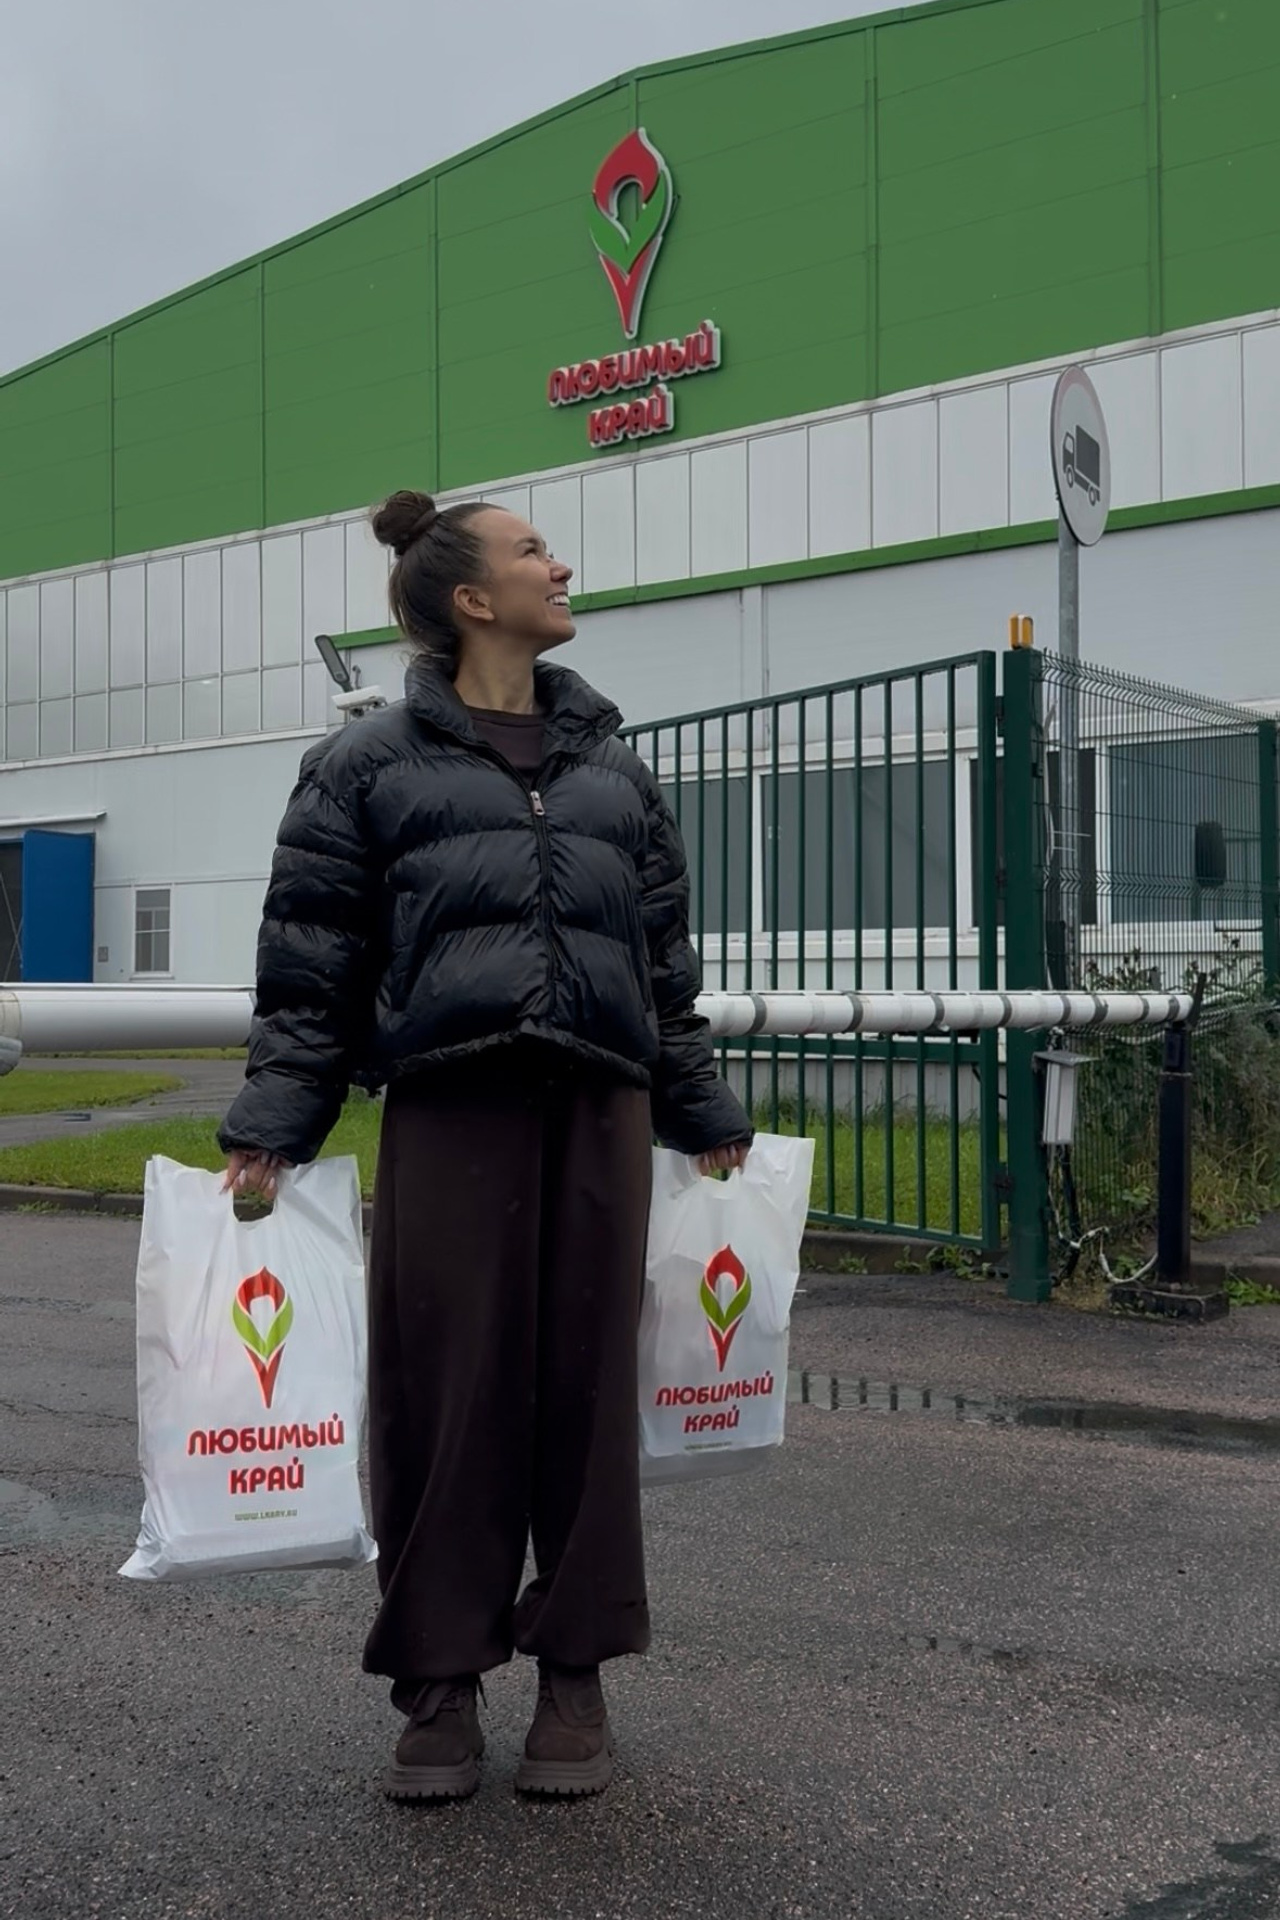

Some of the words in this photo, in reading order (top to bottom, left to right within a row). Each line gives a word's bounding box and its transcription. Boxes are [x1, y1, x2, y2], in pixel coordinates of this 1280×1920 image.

[548, 319, 720, 407] ЛЮБИМЫЙ
[587, 383, 674, 447] КРАЙ
[656, 1370, 774, 1406] ЛЮБИМЫЙ
[188, 1412, 345, 1456] ЛЮБИМЫЙ
[684, 1404, 740, 1433] КРАЙ
[230, 1456, 304, 1494] КРАЙ
